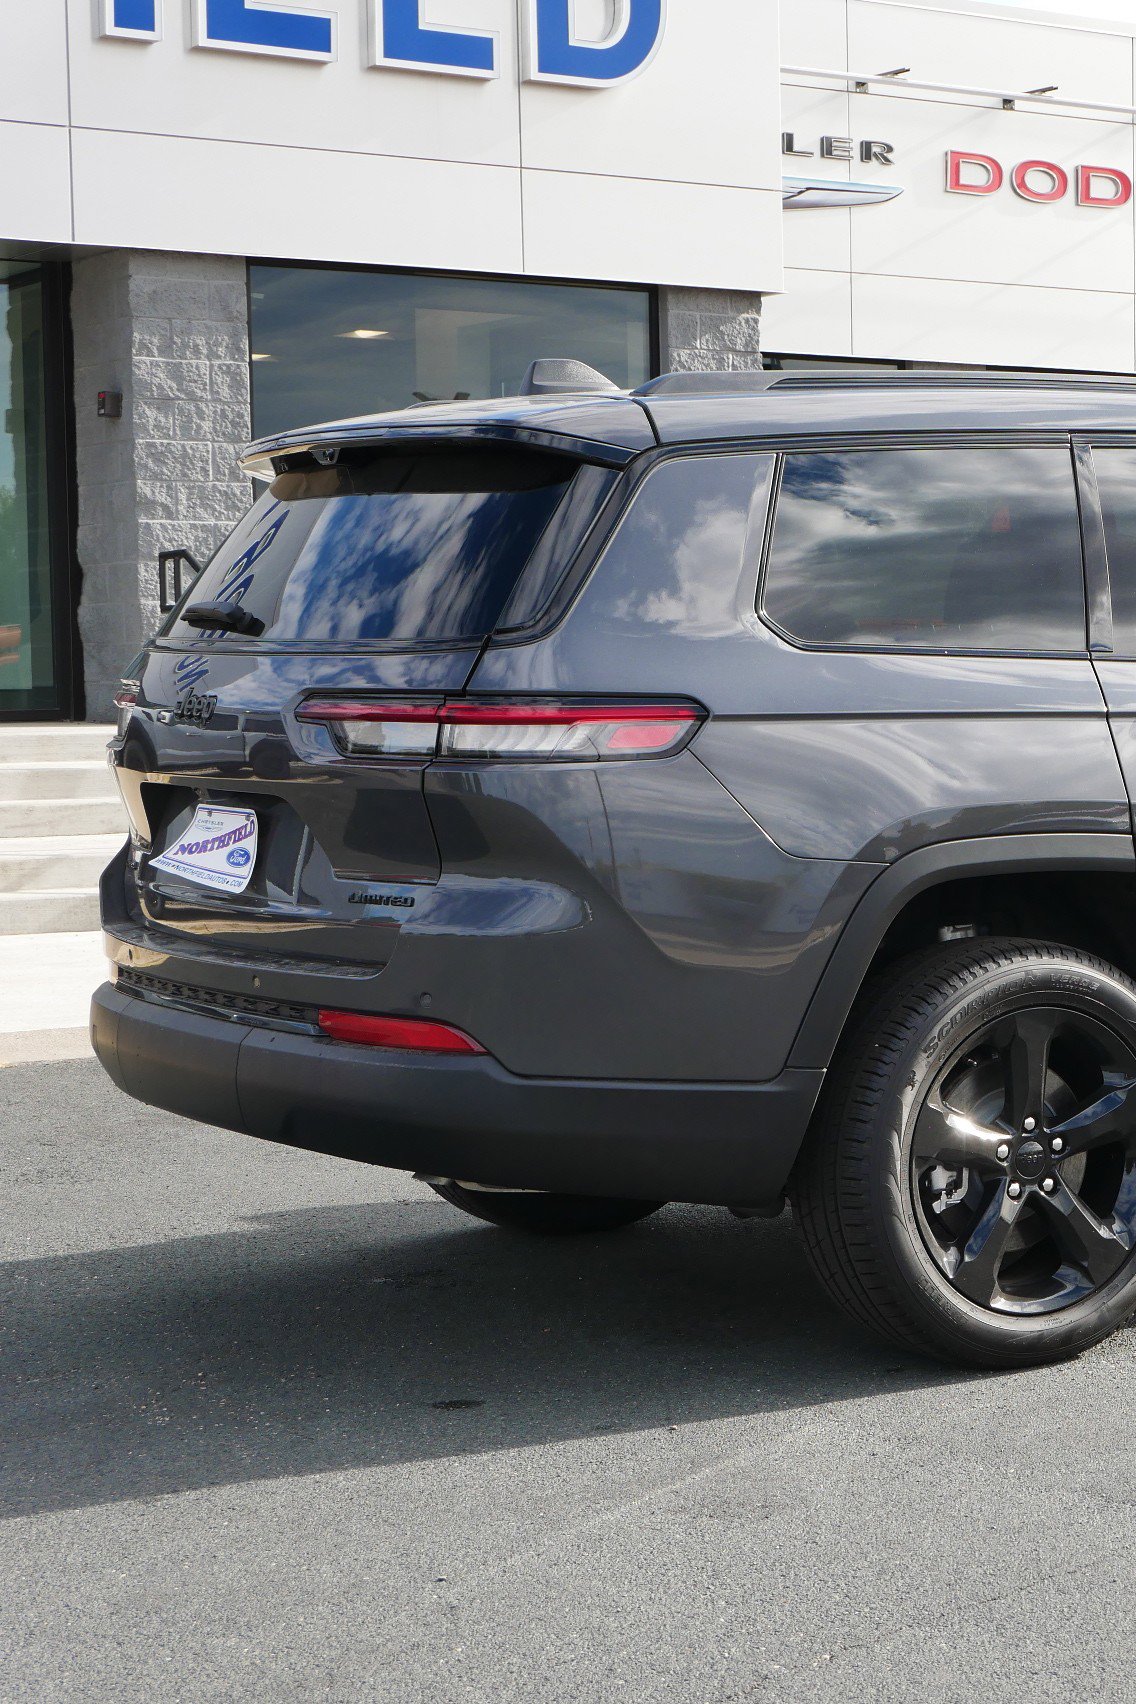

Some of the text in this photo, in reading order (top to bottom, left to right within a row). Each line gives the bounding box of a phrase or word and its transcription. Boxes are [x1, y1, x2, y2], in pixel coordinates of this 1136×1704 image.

[174, 687, 218, 728] Jeep
[173, 818, 256, 856] NORTHFIELD
[230, 850, 248, 864] Ford
